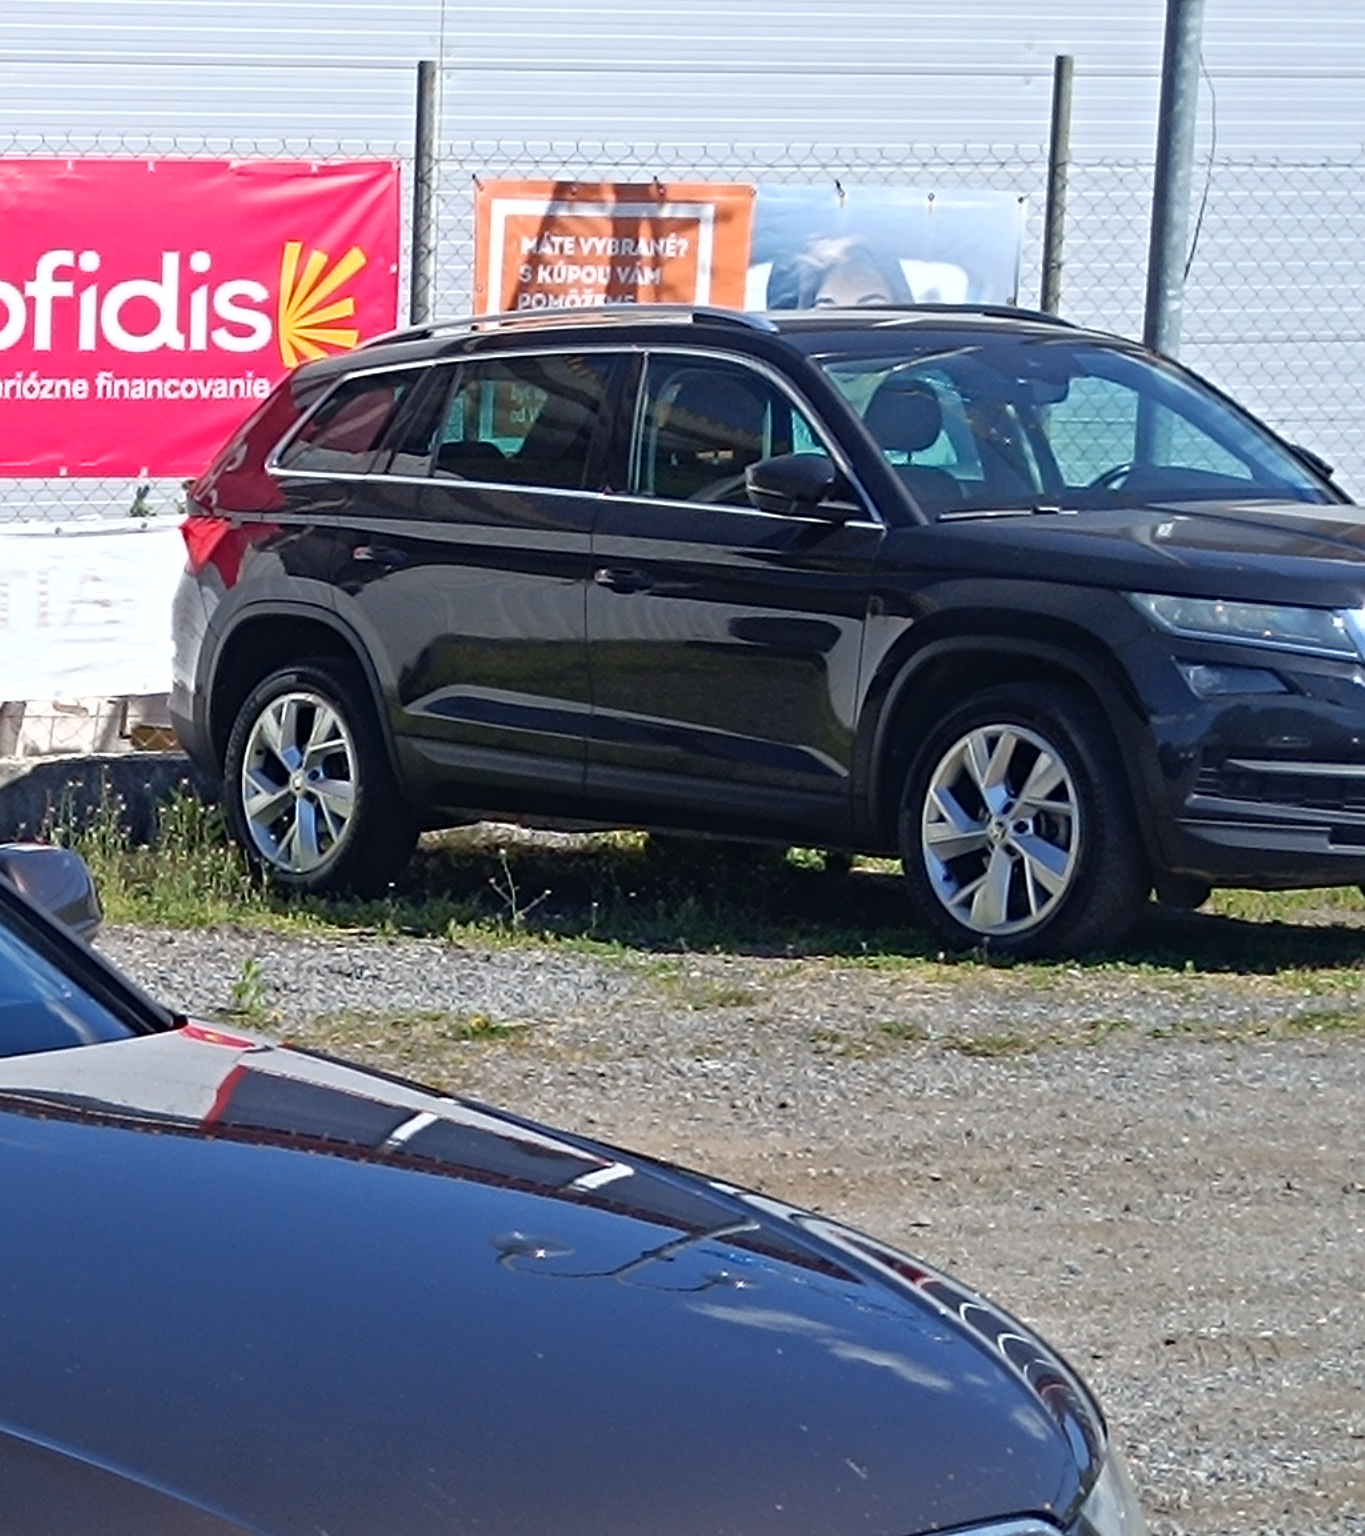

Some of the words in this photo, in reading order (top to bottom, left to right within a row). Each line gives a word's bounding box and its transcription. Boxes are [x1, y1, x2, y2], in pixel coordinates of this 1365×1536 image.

[520, 231, 575, 257] MÁTE
[580, 232, 689, 258] VYBRANÉ?
[519, 264, 533, 283] S
[537, 260, 610, 285] KÚPOU
[617, 263, 662, 285] VÁM
[95, 370, 271, 400] financovanie
